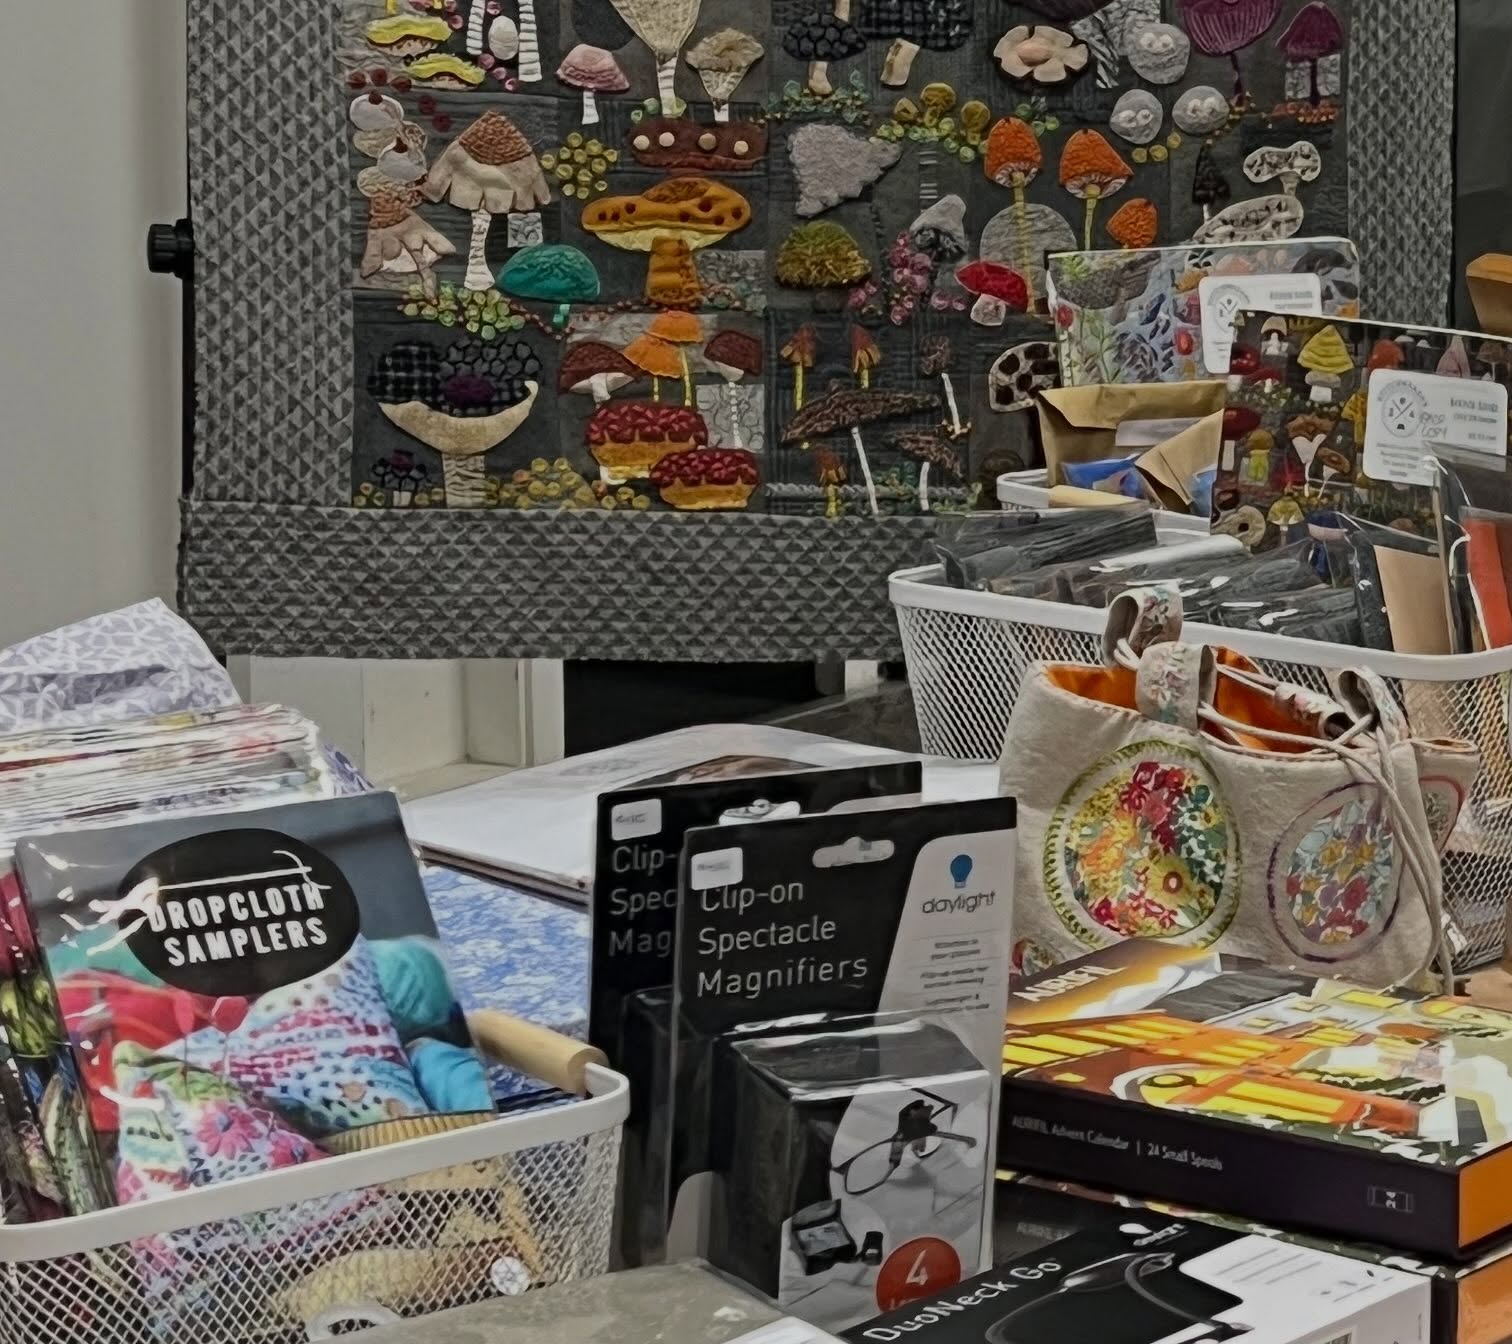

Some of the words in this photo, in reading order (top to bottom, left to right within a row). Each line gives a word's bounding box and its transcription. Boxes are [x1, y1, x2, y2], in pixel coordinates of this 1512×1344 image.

[149, 883, 325, 932] DROPCLOTH
[701, 881, 804, 916] Clip-on
[922, 890, 996, 914] daylight
[164, 917, 328, 967] SAMPLERS
[698, 914, 837, 960] Spectacle
[697, 957, 868, 999] Magnifiers
[905, 1248, 930, 1286] 4
[863, 1281, 1019, 1341] DuoNeck
[1010, 1261, 1062, 1280] Go
